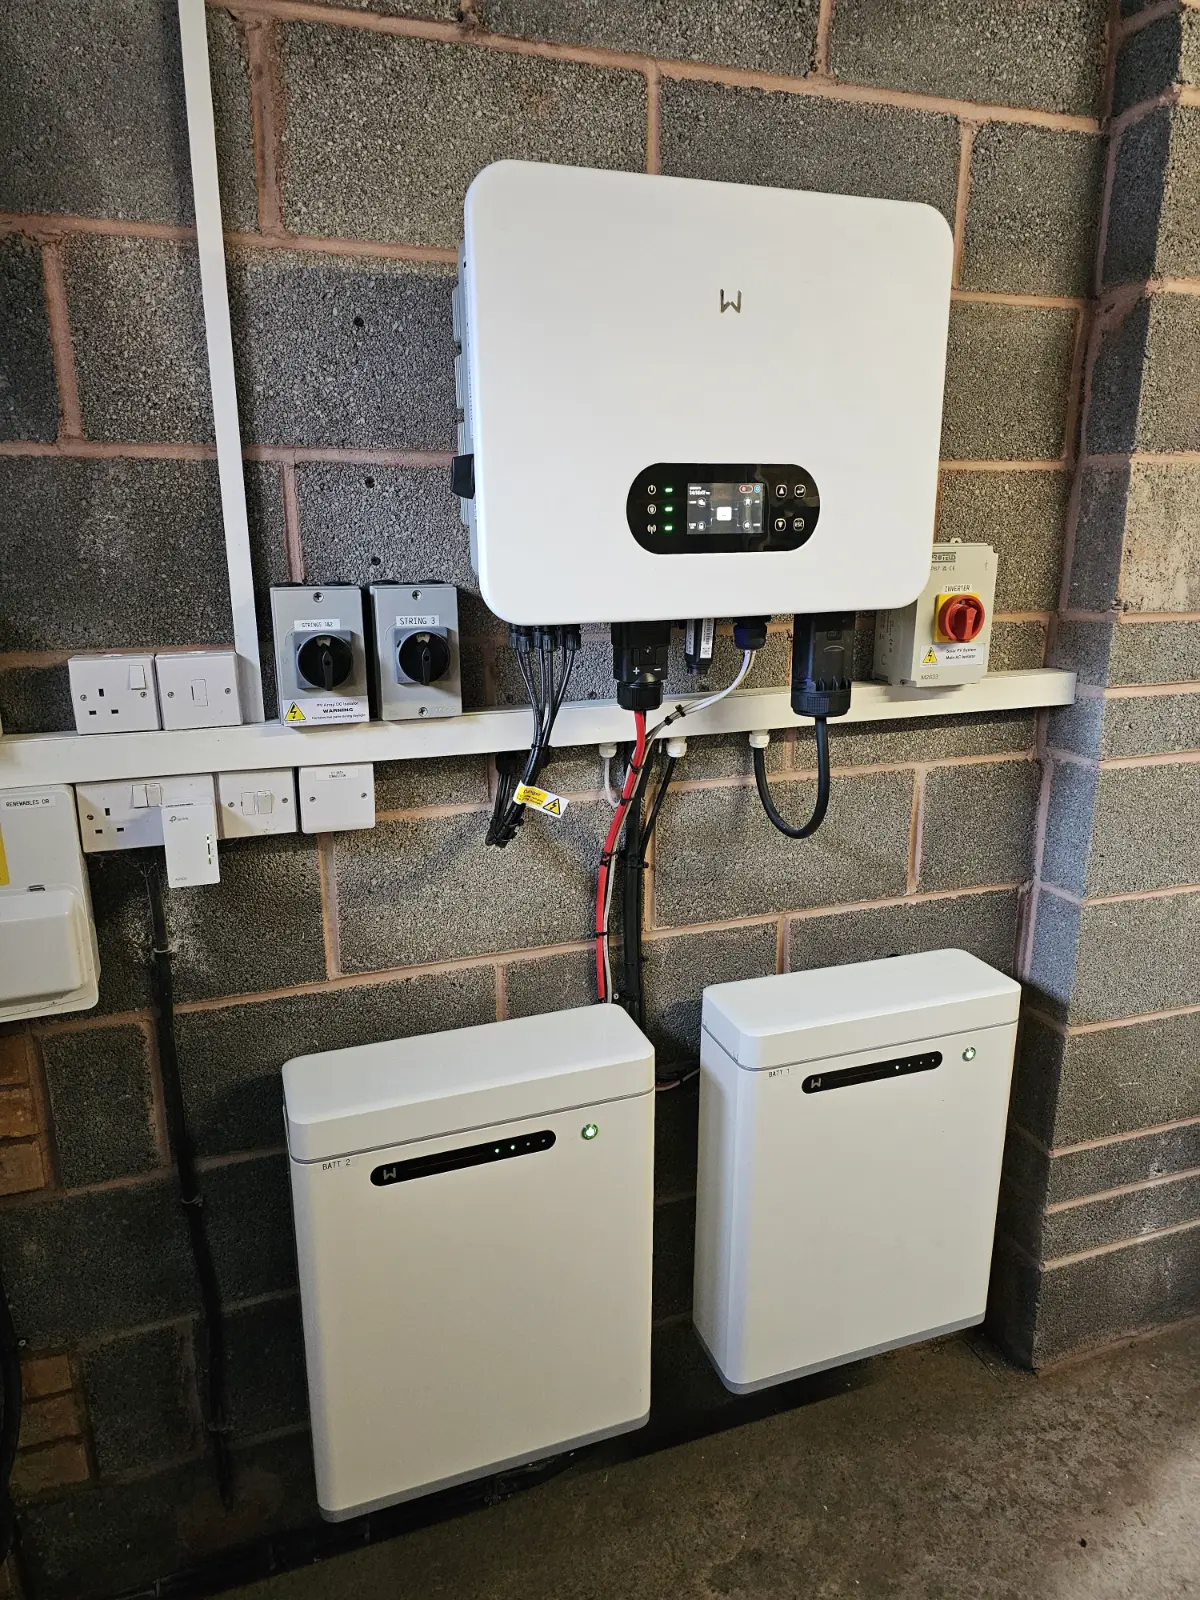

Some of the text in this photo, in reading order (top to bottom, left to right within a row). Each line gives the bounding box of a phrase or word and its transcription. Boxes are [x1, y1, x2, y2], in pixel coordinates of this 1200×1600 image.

[944, 584, 971, 592] INVERTER
[399, 616, 436, 625] STRING 3
[768, 1069, 783, 1078] BATT
[322, 1158, 351, 1170] BATT 2
